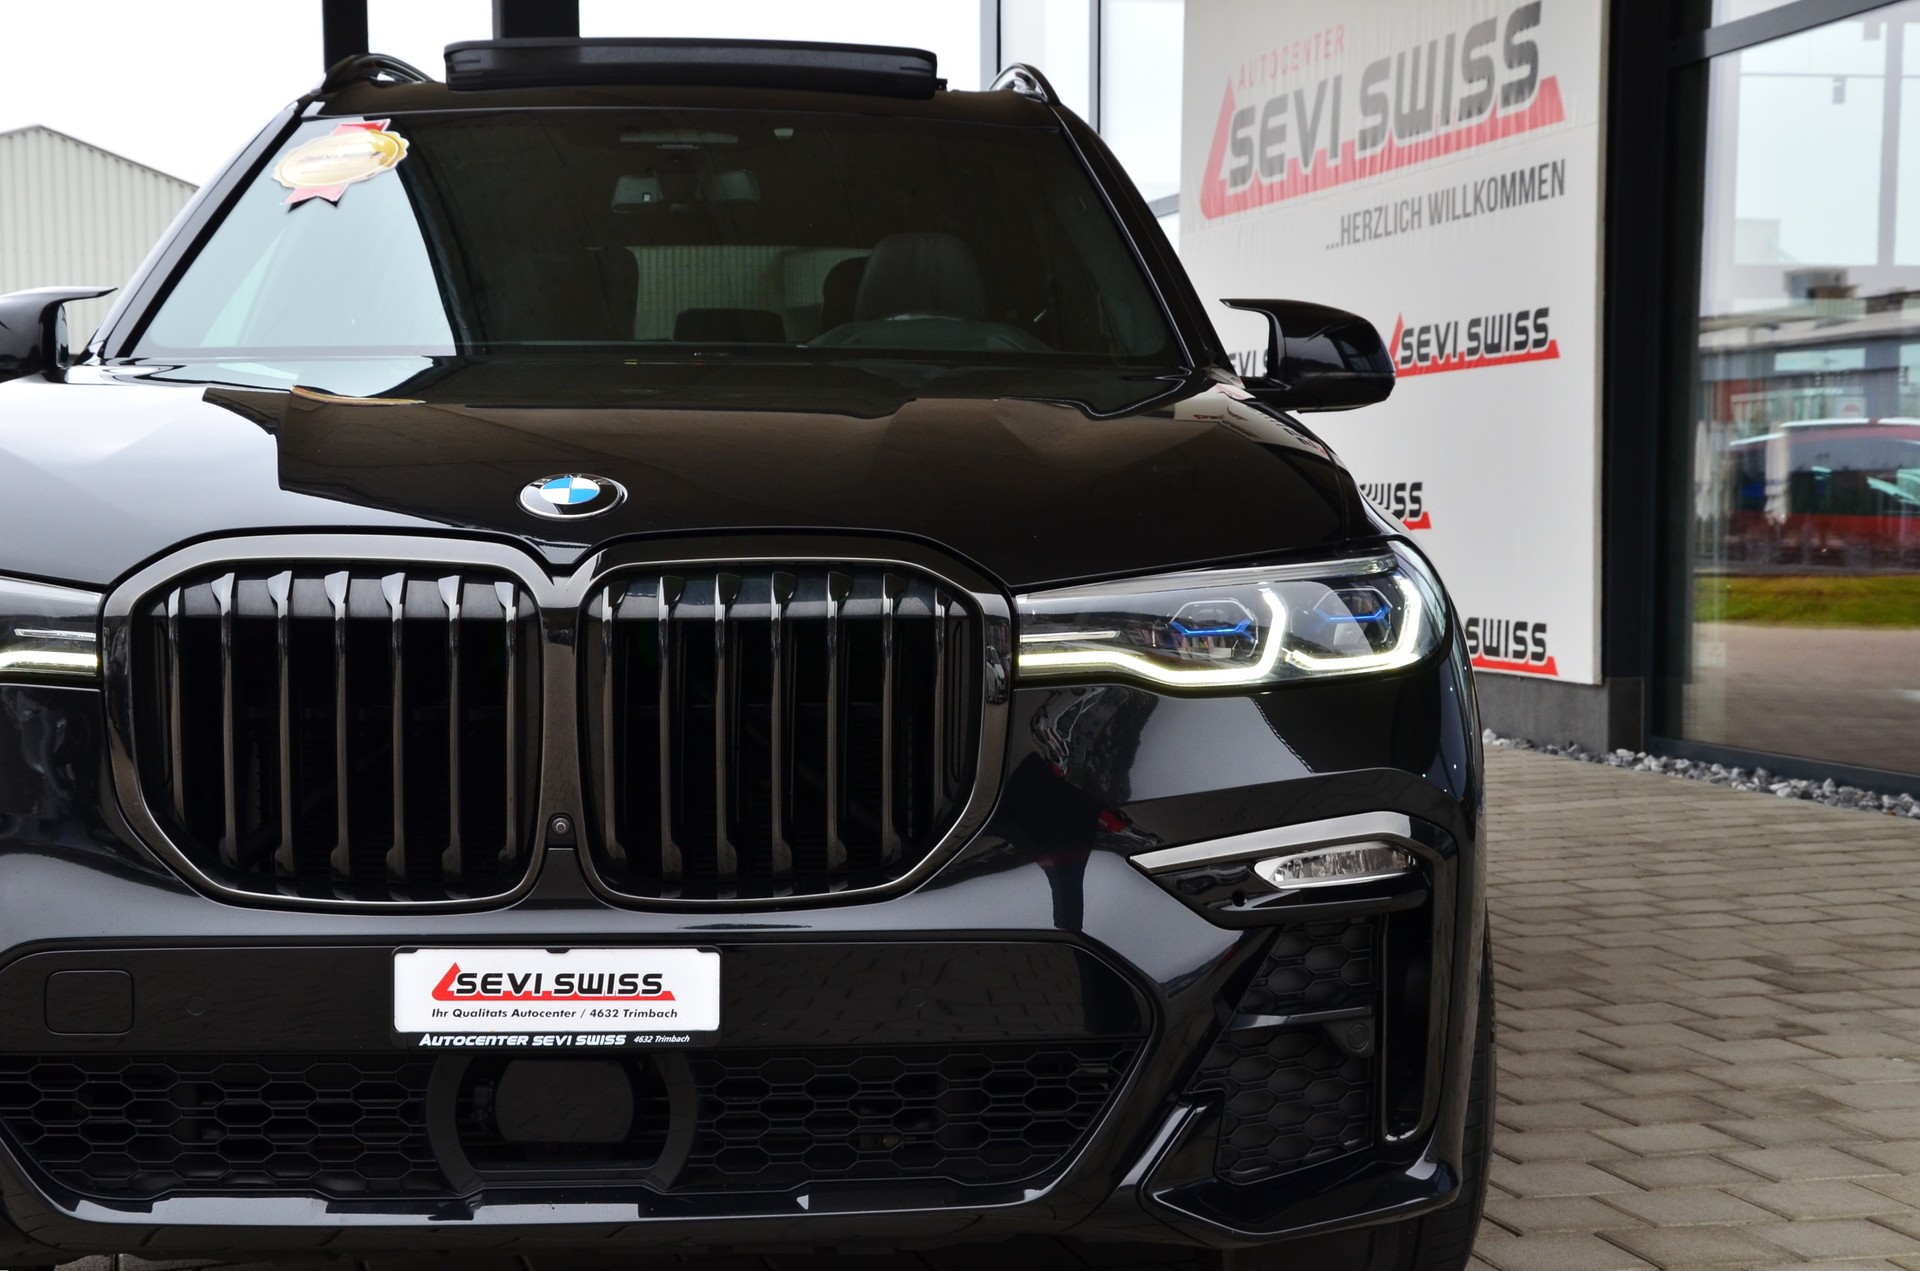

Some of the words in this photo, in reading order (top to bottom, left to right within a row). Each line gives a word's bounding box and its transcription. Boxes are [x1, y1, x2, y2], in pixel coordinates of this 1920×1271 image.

[1238, 23, 1344, 91] AUTOCENTER
[1228, 74, 1342, 189] SEVI
[1358, 1, 1542, 153] SWISS
[1428, 158, 1566, 227] WILLKOMMEN
[1400, 321, 1459, 365] SEVI
[1466, 307, 1549, 357] SWISS
[1464, 617, 1547, 662] SWISS
[456, 973, 543, 995] SEVI
[553, 973, 662, 995] SWISS
[431, 1008, 449, 1018] Ihr
[452, 1008, 508, 1018] Qualitats
[511, 1008, 577, 1018] Autocenter
[589, 1009, 619, 1018] 4632
[623, 1008, 678, 1018] Trimbach
[532, 1035, 572, 1046] SEVI
[575, 1035, 626, 1046] SWISS
[655, 1034, 690, 1043] Trimbach
